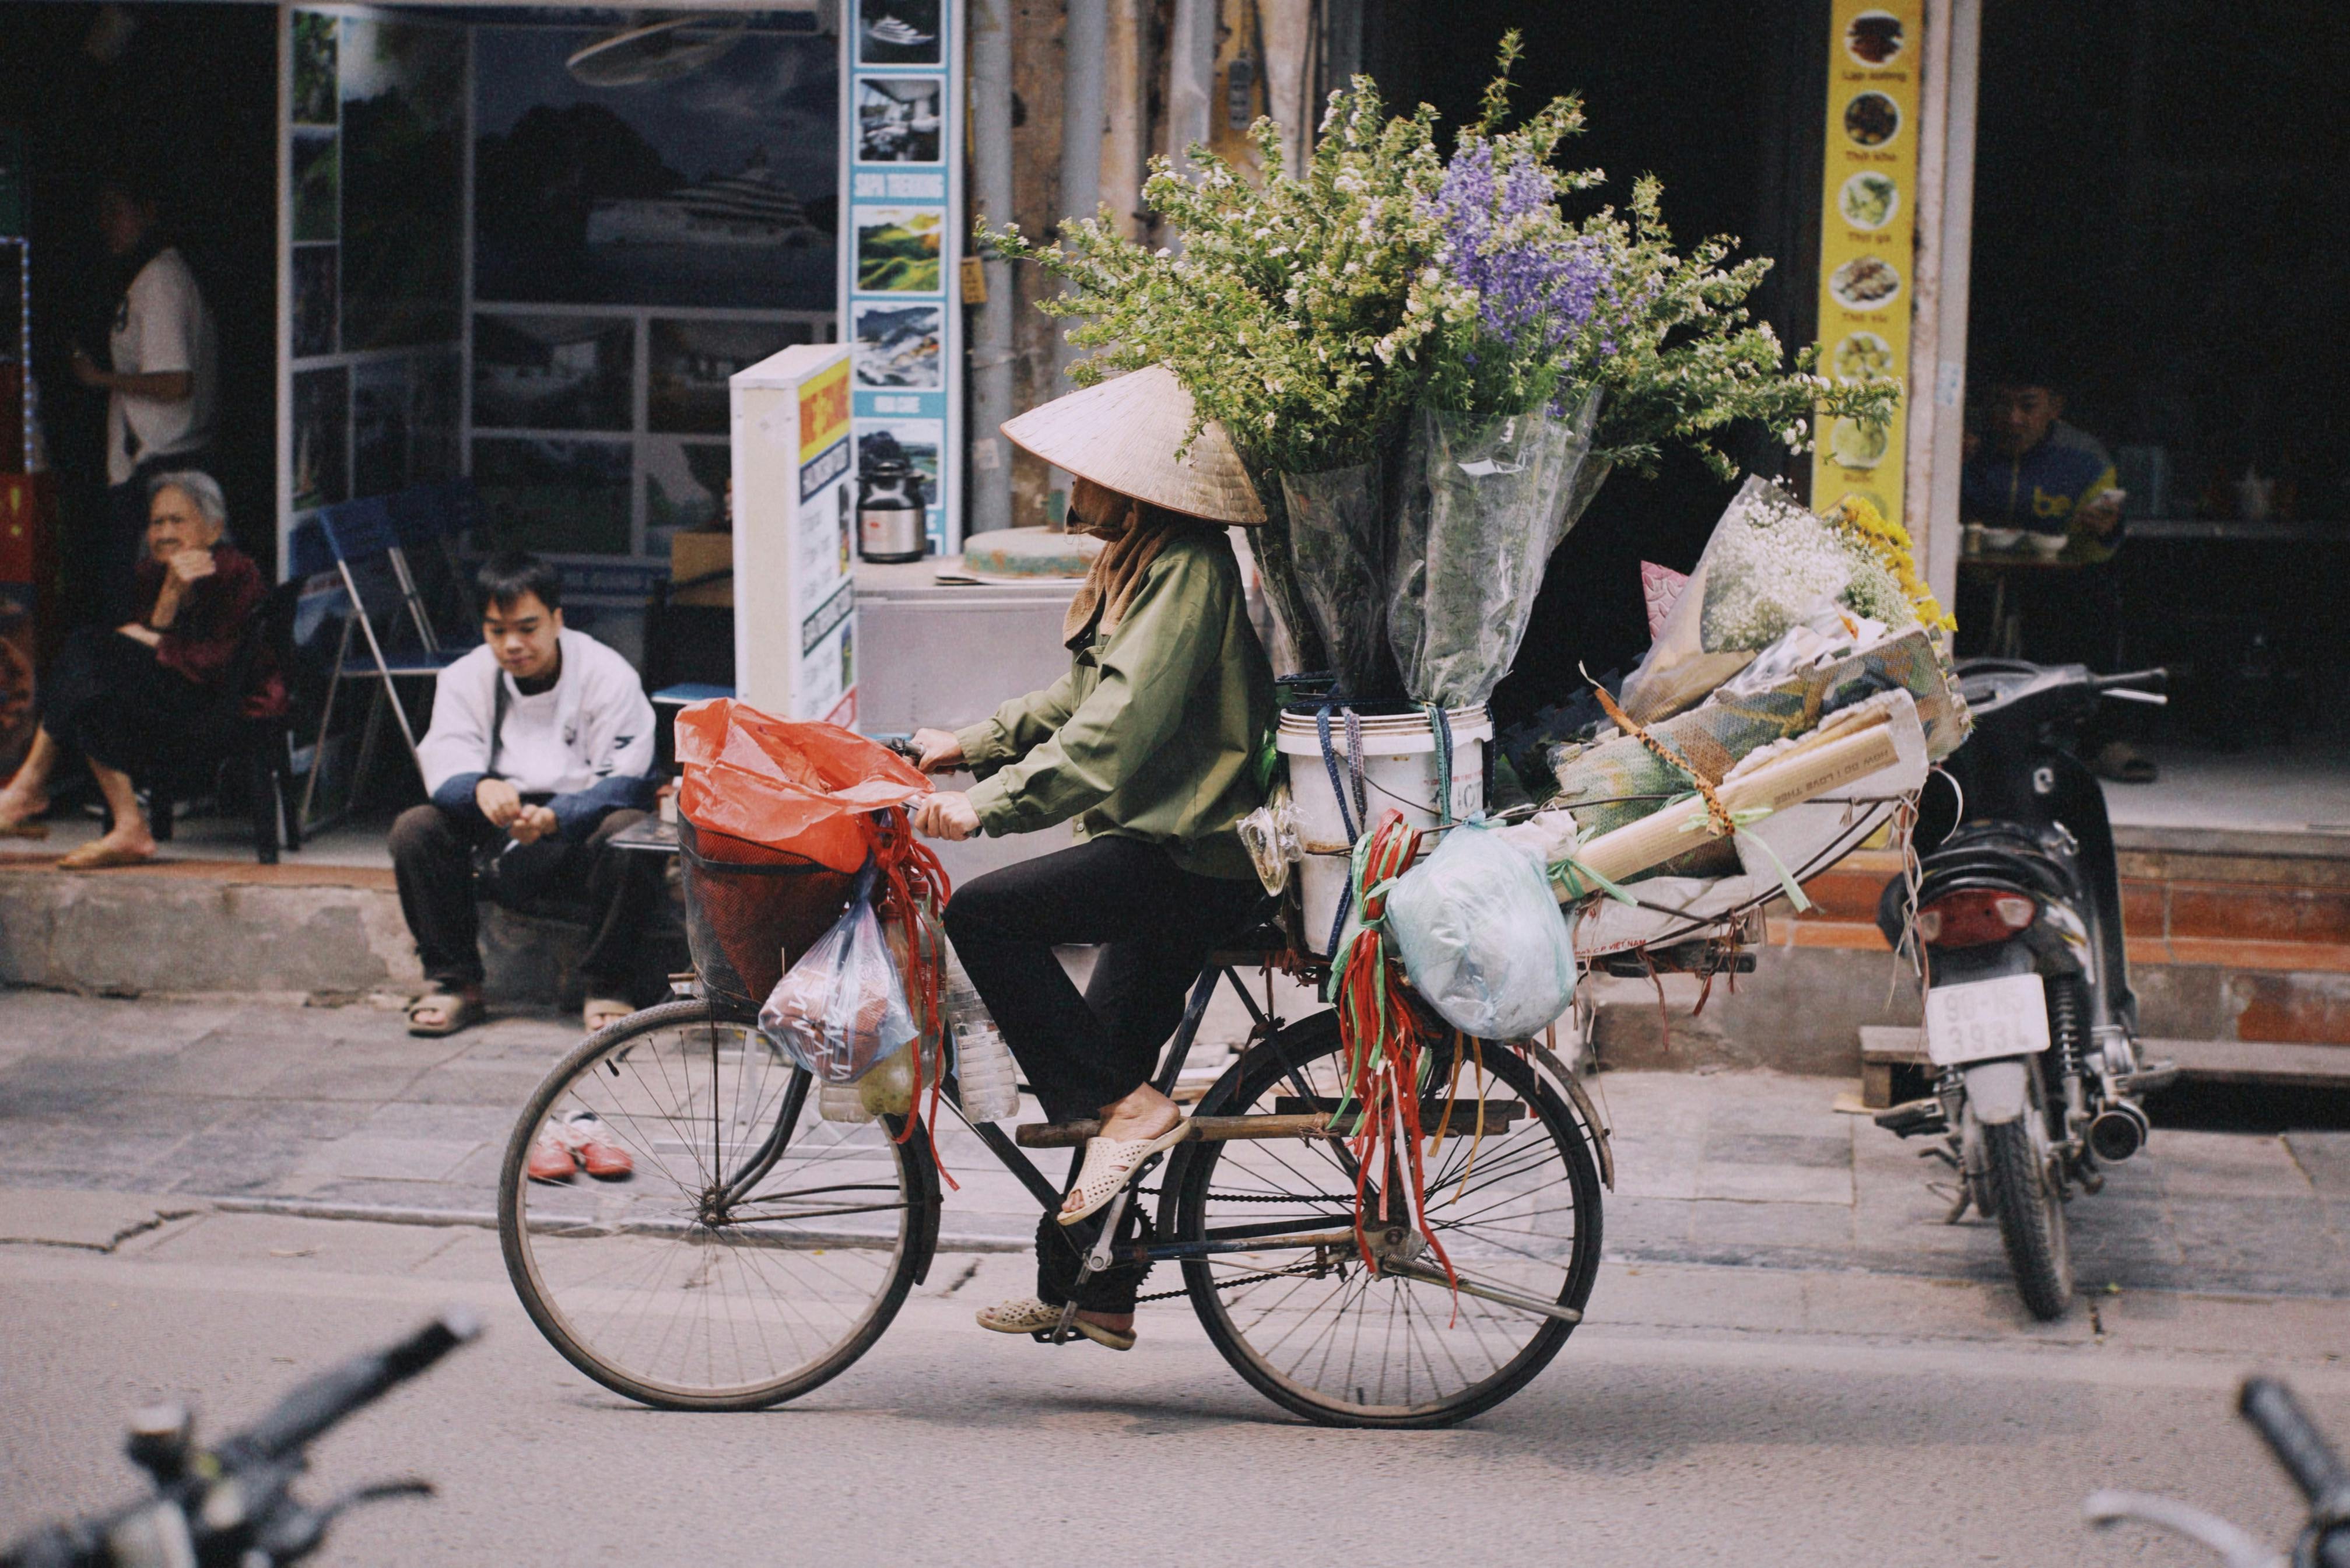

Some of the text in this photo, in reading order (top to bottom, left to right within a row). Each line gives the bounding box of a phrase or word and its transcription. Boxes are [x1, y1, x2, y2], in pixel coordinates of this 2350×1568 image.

[1864, 750, 1888, 764] HOW
[1844, 763, 1860, 774] DO
[1806, 774, 1834, 789] LOVE
[1774, 788, 1802, 804] THEE
